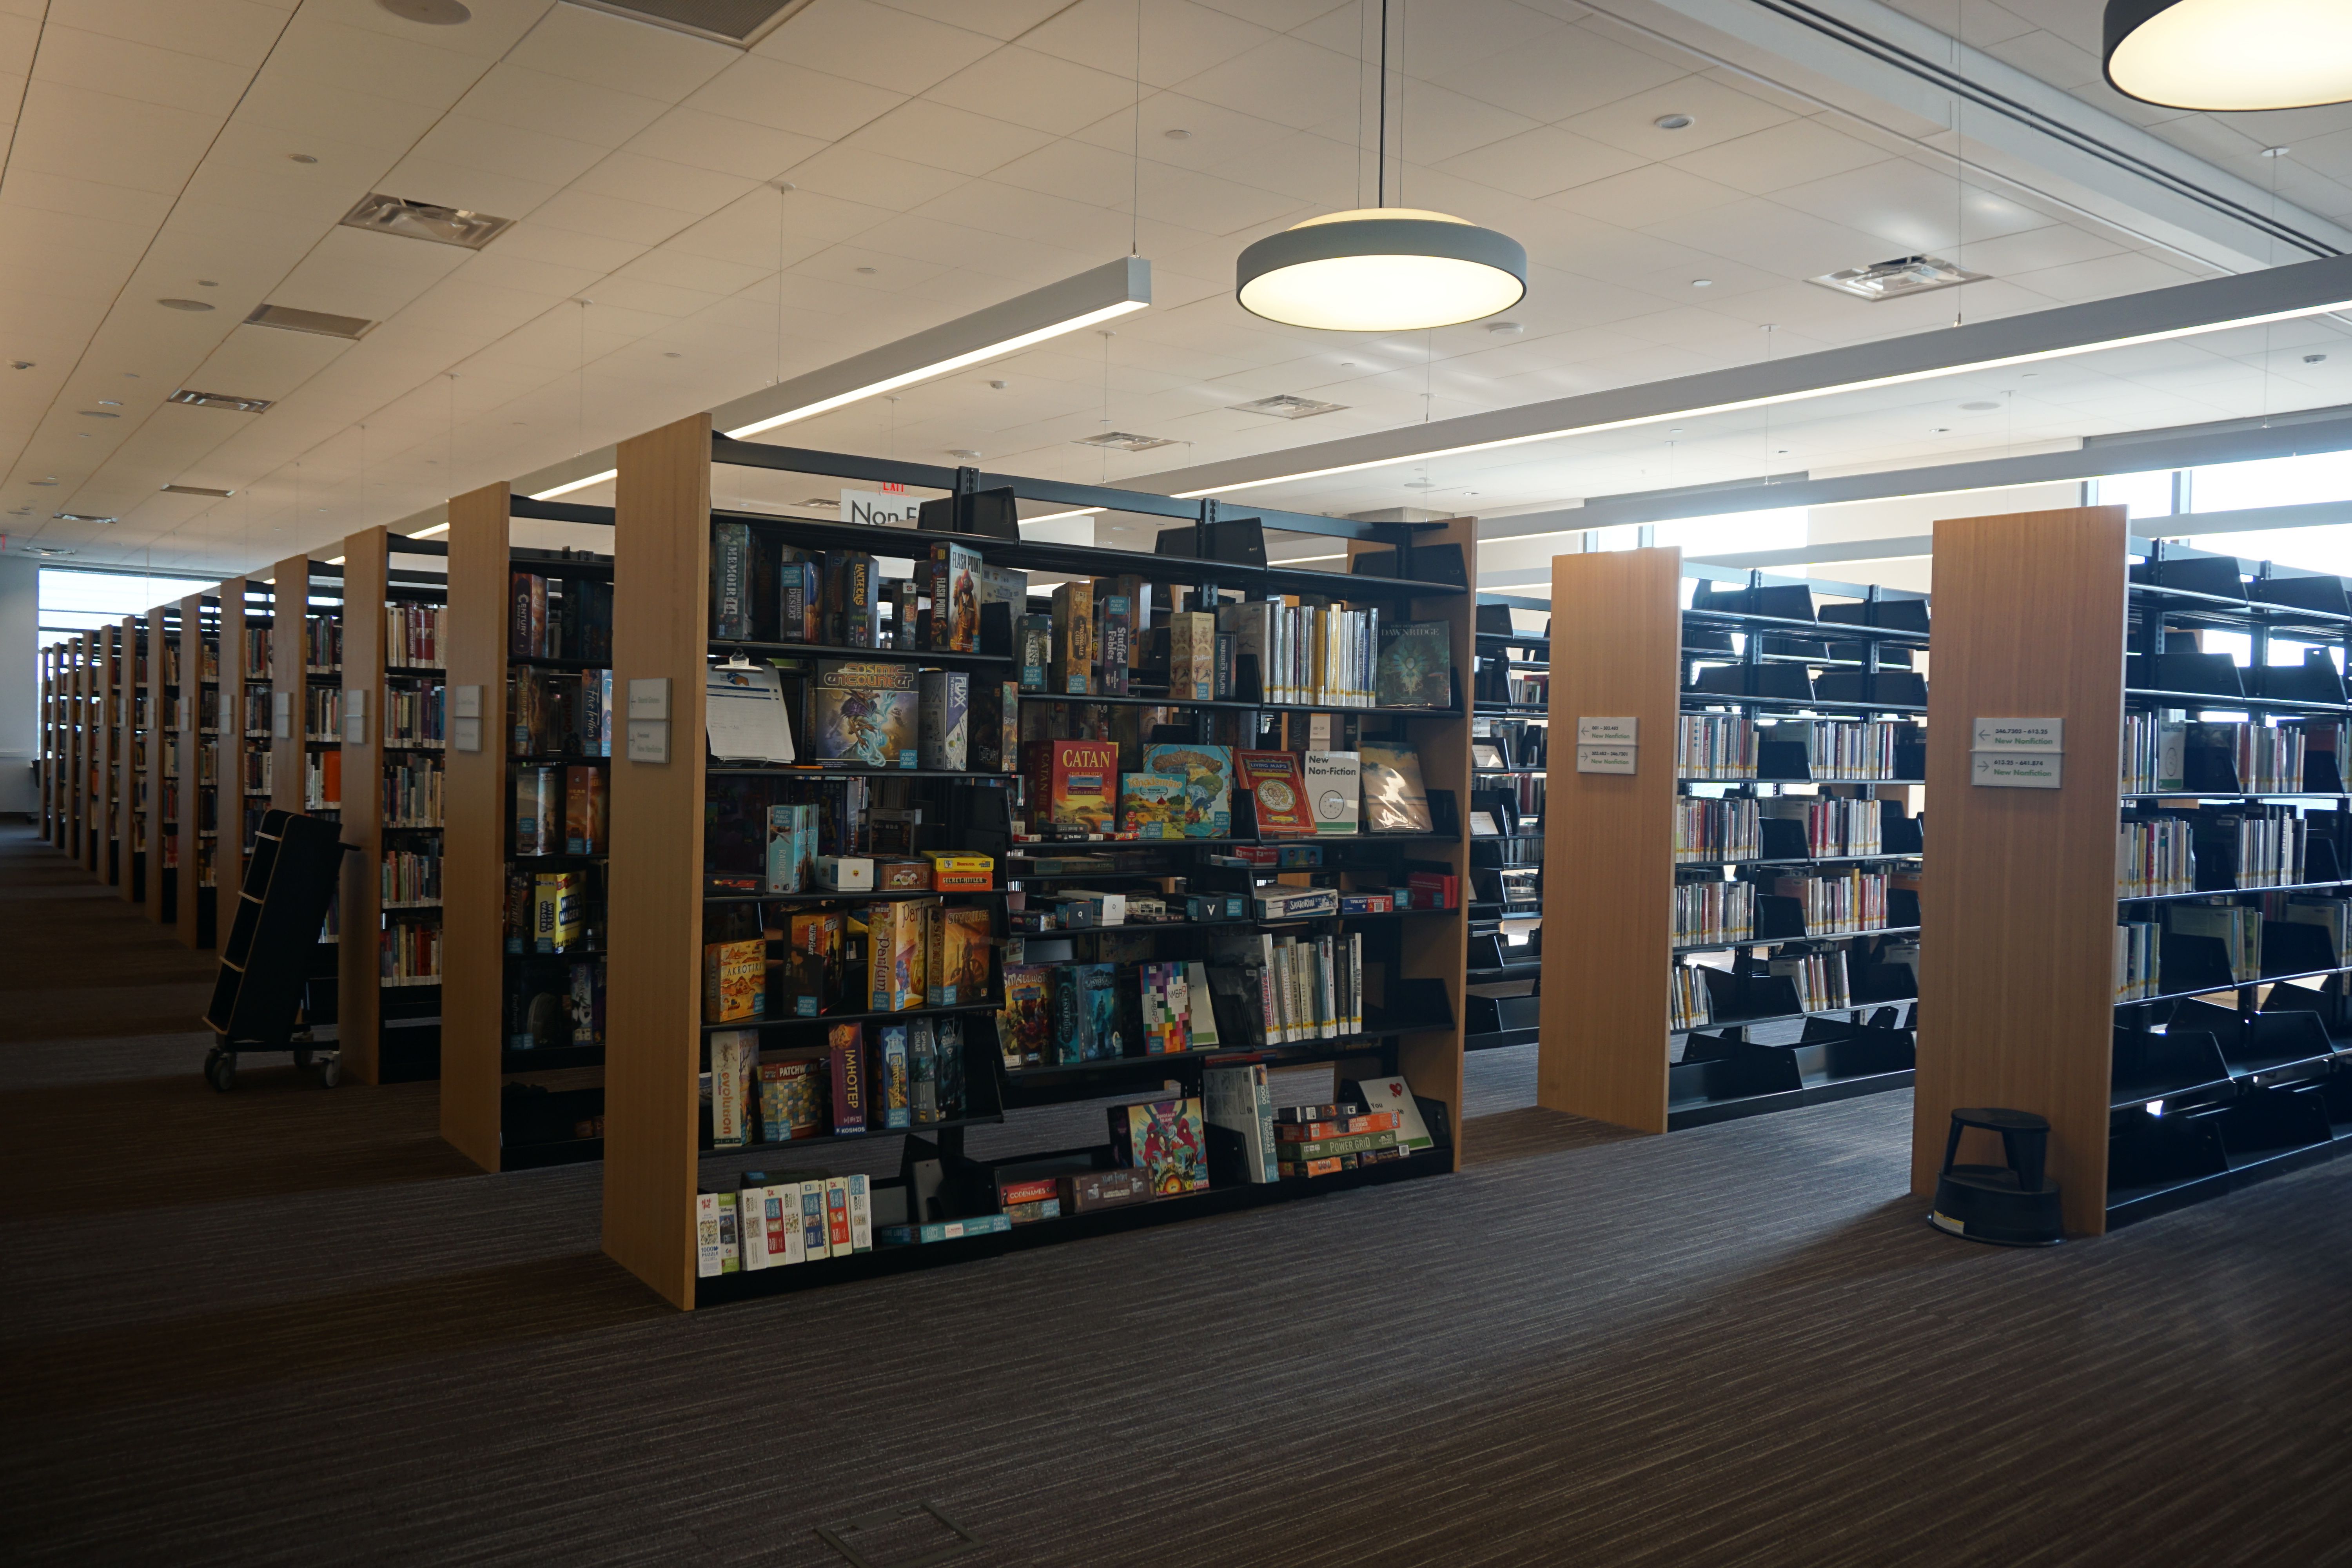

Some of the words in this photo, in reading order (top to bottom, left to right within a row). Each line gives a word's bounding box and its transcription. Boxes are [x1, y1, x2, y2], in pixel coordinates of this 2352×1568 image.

[852, 499, 916, 524] Non-F
[726, 546, 738, 597] MEMOIR
[952, 551, 967, 570] FLASH
[968, 555, 982, 573] POINT
[855, 563, 865, 606] LANTERNS
[936, 578, 946, 597] FLASH
[517, 593, 528, 637] CENTURY
[936, 598, 946, 618] POINT
[1107, 630, 1116, 661] Fables
[1117, 627, 1127, 664] Stuffed
[843, 662, 906, 675] COSMIC
[955, 676, 967, 709] FLUXX
[978, 745, 1000, 762] GATEWAY
[1062, 749, 1111, 768] CATAN
[1040, 753, 1050, 791] CATAN
[1127, 776, 1183, 789] Kingdomino
[1308, 767, 1356, 776] Non-Fiction
[778, 849, 786, 881] RAIDERS
[561, 896, 575, 909] WITS
[1289, 897, 1316, 910] SANTORINI
[727, 962, 762, 976] AKROTIRI
[845, 1049, 858, 1109] IMHOTEP
[721, 1072, 732, 1134] evolution
[1263, 1117, 1271, 1154] TRUDGIAN
[1329, 1141, 1353, 1153] POWER
[1354, 1137, 1371, 1149] GRID
[1010, 1189, 1045, 1200] CODENAMES
